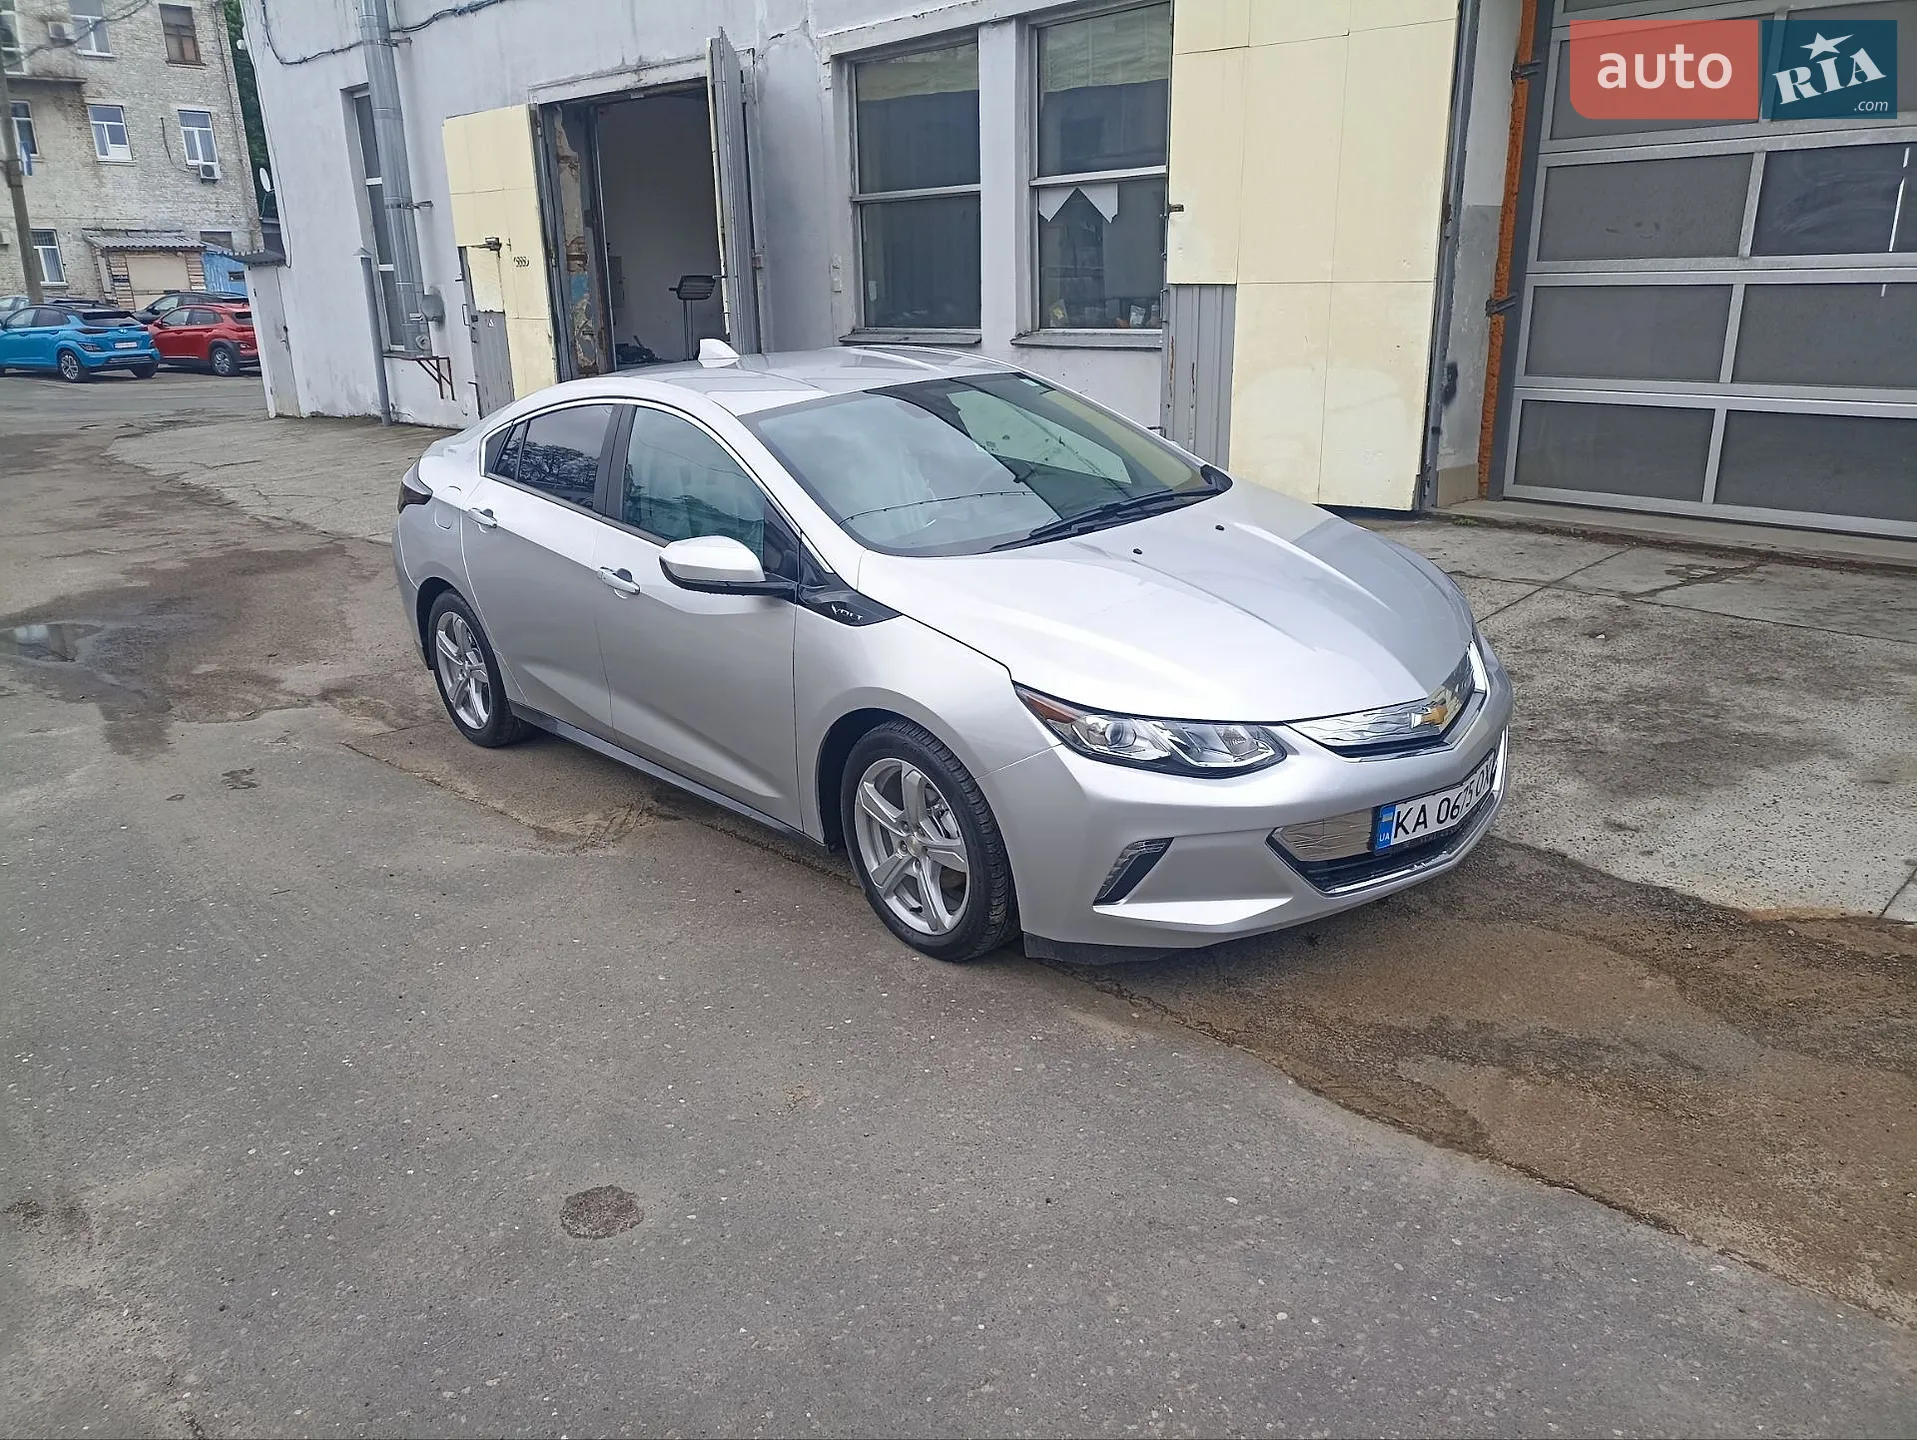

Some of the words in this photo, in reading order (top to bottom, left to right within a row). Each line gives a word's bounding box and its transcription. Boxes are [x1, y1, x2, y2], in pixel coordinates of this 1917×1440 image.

[1394, 804, 1428, 838] KA
[1437, 780, 1474, 824] 0675
[1379, 834, 1390, 842] UA
